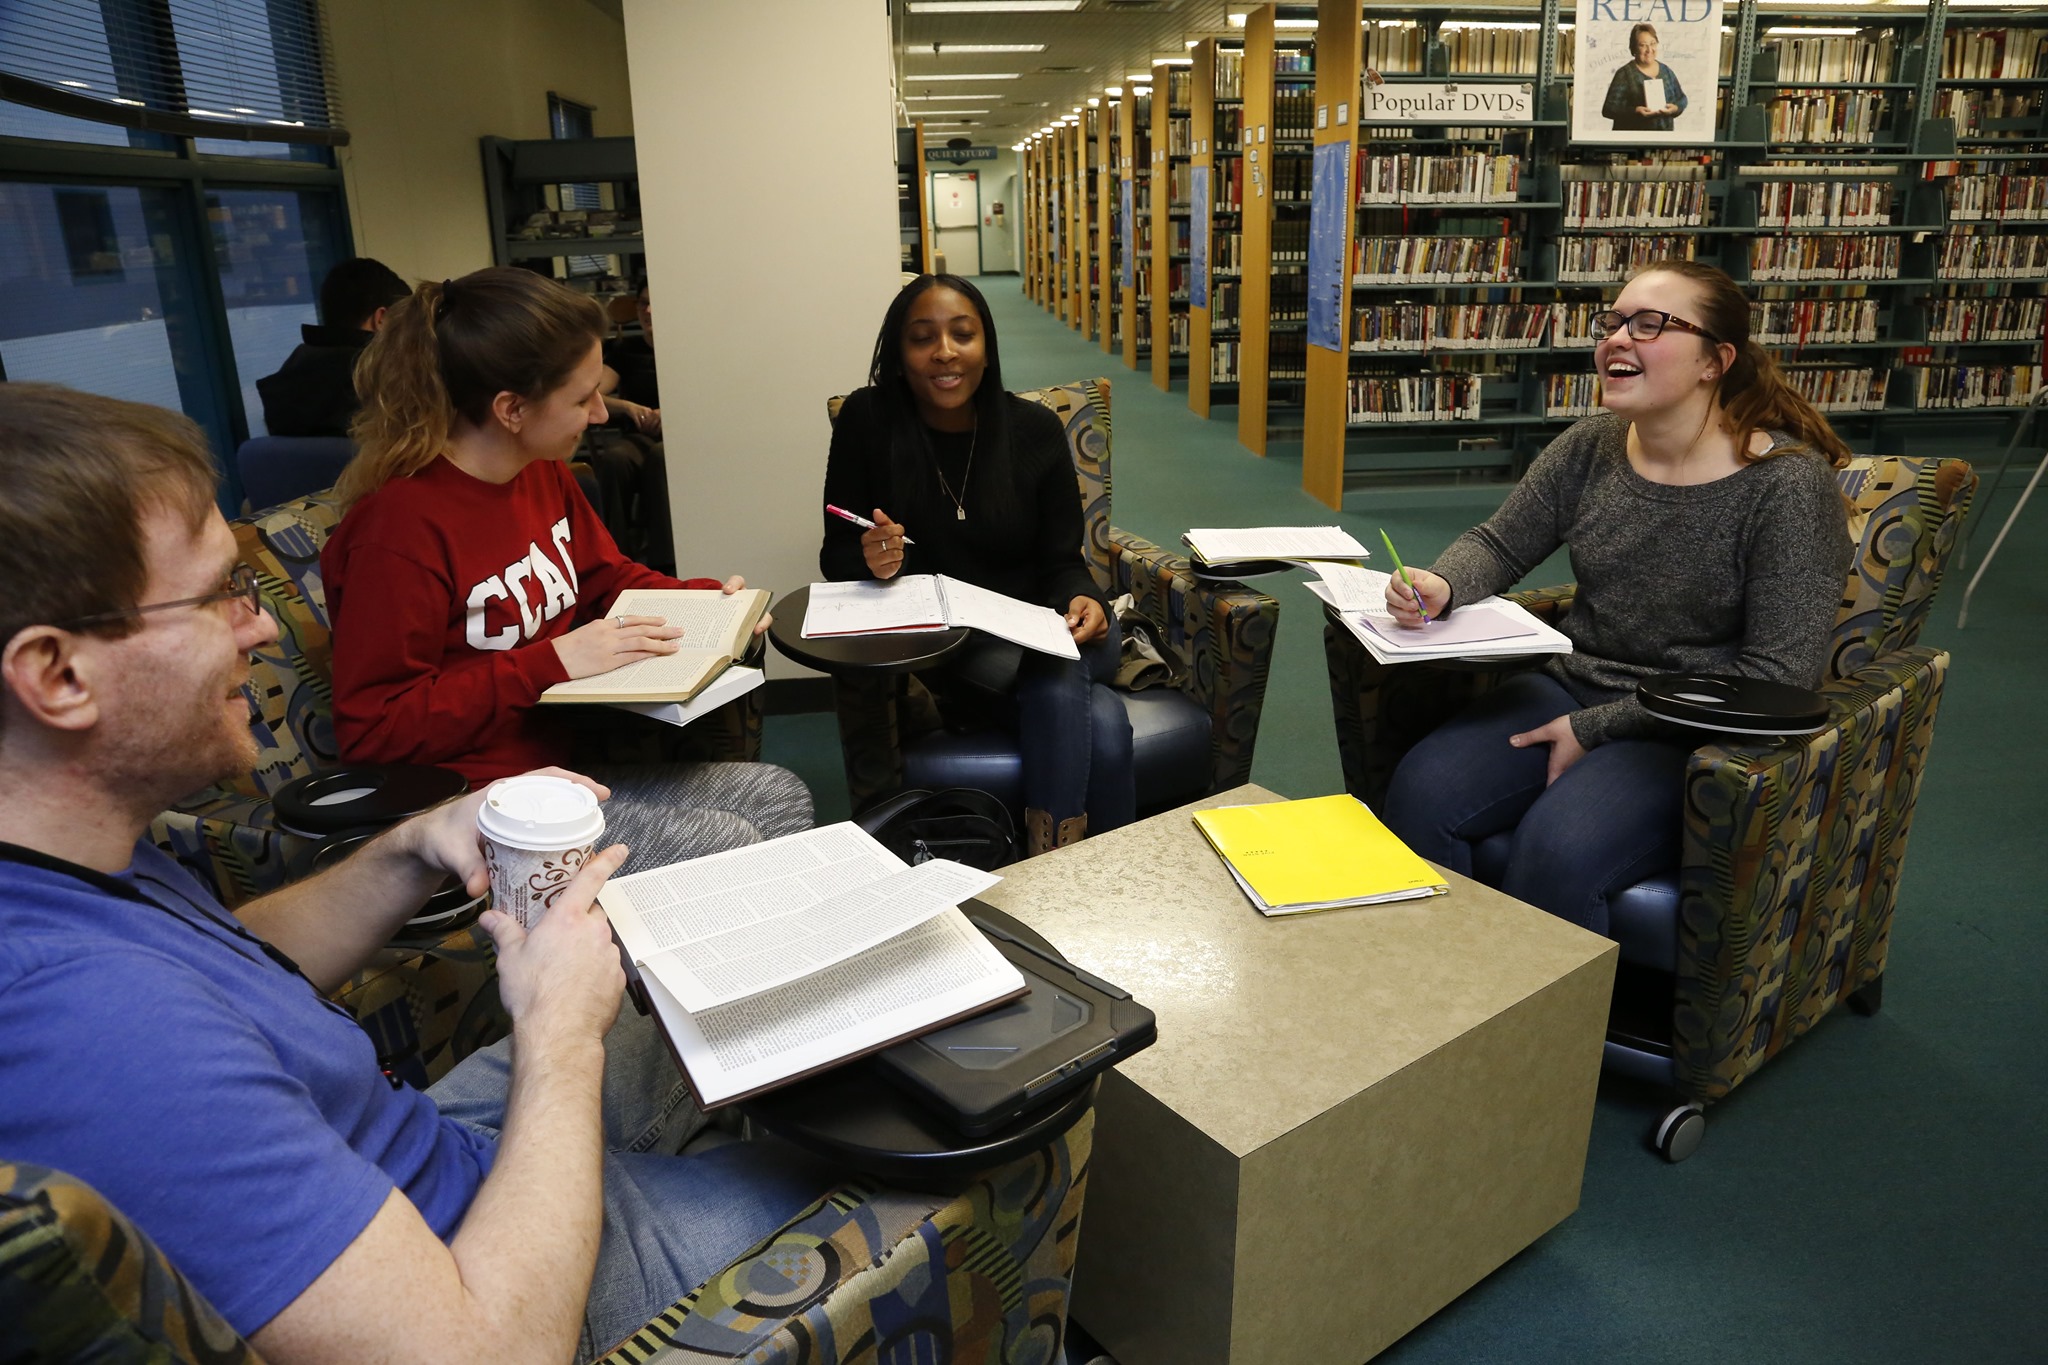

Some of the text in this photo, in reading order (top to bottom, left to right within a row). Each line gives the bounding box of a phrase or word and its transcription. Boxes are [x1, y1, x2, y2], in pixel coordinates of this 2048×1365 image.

[1590, 0, 1713, 22] READ
[1371, 92, 1455, 117] Popular
[1462, 93, 1525, 112] DVDs
[927, 149, 991, 160] QUIET STUDY
